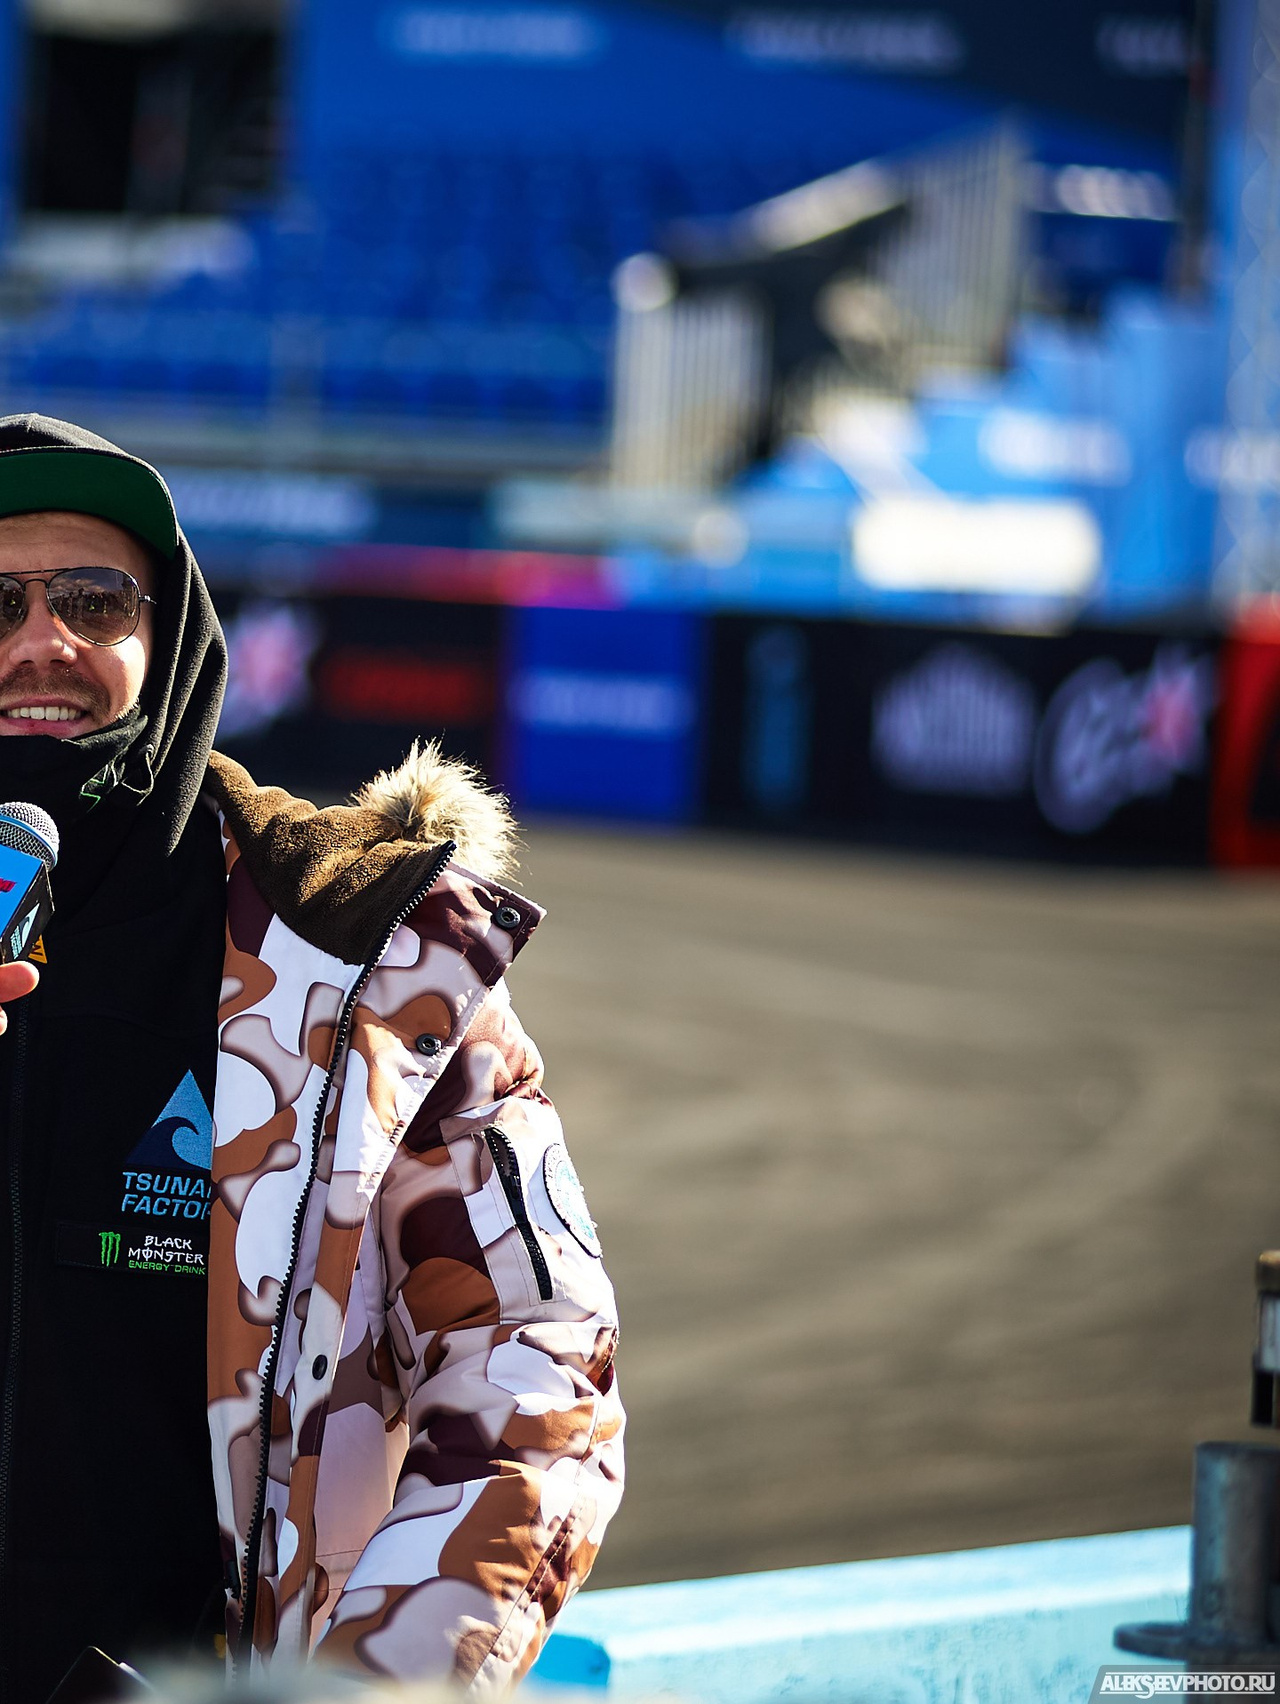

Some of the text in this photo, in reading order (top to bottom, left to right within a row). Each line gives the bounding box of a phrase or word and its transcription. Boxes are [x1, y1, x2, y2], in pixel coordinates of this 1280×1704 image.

[122, 1172, 211, 1199] TSUNA
[144, 1235, 192, 1251] BLACK
[128, 1260, 206, 1275] ENERGY DRINK
